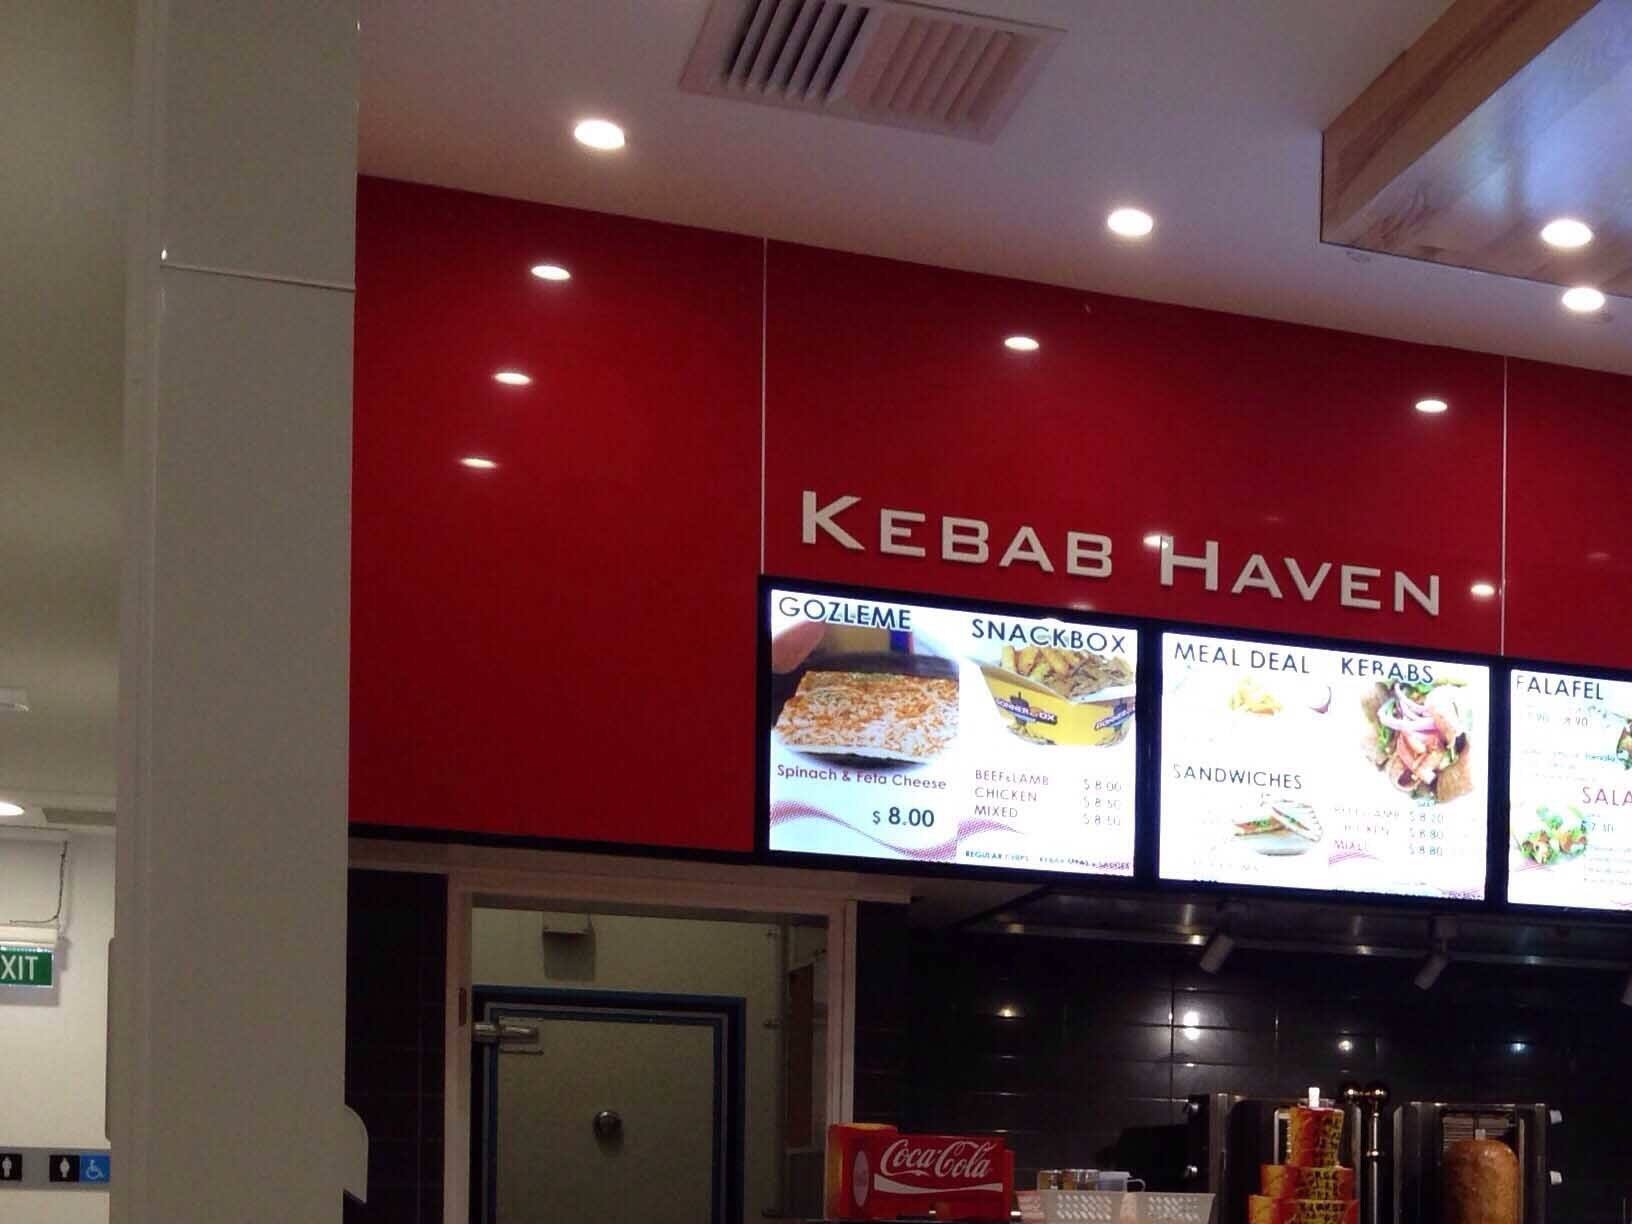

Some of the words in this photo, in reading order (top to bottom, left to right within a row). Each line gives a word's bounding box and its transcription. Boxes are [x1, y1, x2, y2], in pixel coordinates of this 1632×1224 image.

[802, 490, 1113, 578] KEBAB
[1160, 534, 1440, 616] HAVEN
[778, 596, 912, 630] GOZLEME
[971, 618, 1126, 653] SNACKBOX
[1173, 642, 1240, 666] MEAL
[1251, 650, 1310, 674] DEAL
[1516, 675, 1604, 701] FALAFEL
[777, 764, 837, 783] Spinach
[842, 769, 851, 782] &
[856, 769, 887, 785] Feta
[892, 773, 947, 790] Cheese
[1095, 780, 1122, 792] 800
[1172, 763, 1302, 789] SANDWICHES
[974, 786, 1037, 802] CHICKEN
[872, 810, 881, 825] $
[888, 806, 935, 827] 8.00
[974, 804, 1018, 818] MIXED
[0, 955, 38, 980] XIT
[880, 1138, 996, 1179] Coca-Cola
